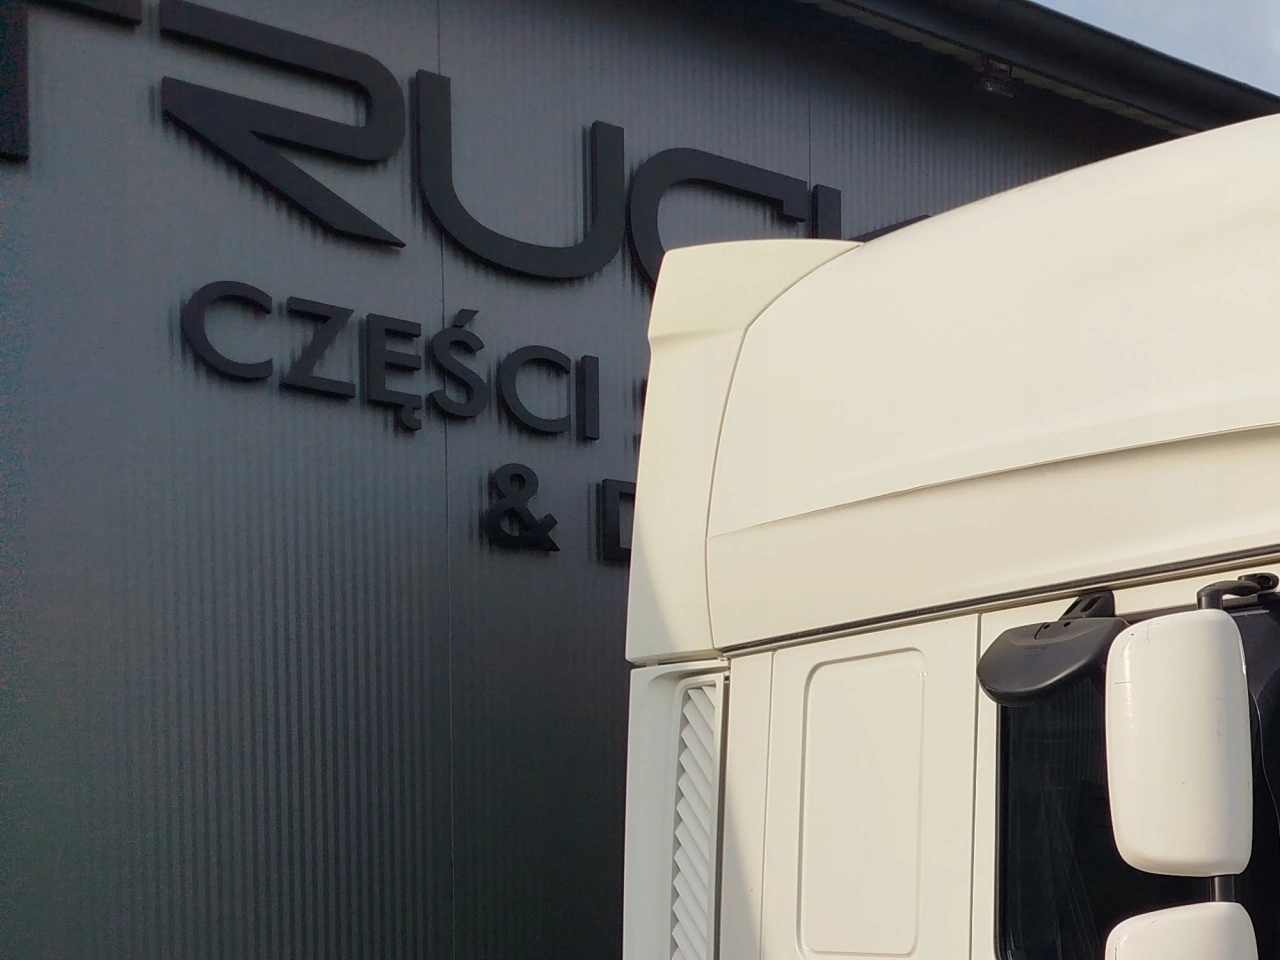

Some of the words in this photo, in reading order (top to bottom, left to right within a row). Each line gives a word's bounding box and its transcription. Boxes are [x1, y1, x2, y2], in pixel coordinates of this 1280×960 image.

[0, 0, 930, 286] RUC
[184, 280, 599, 442] CZĘŚCI
[484, 463, 559, 551] &
